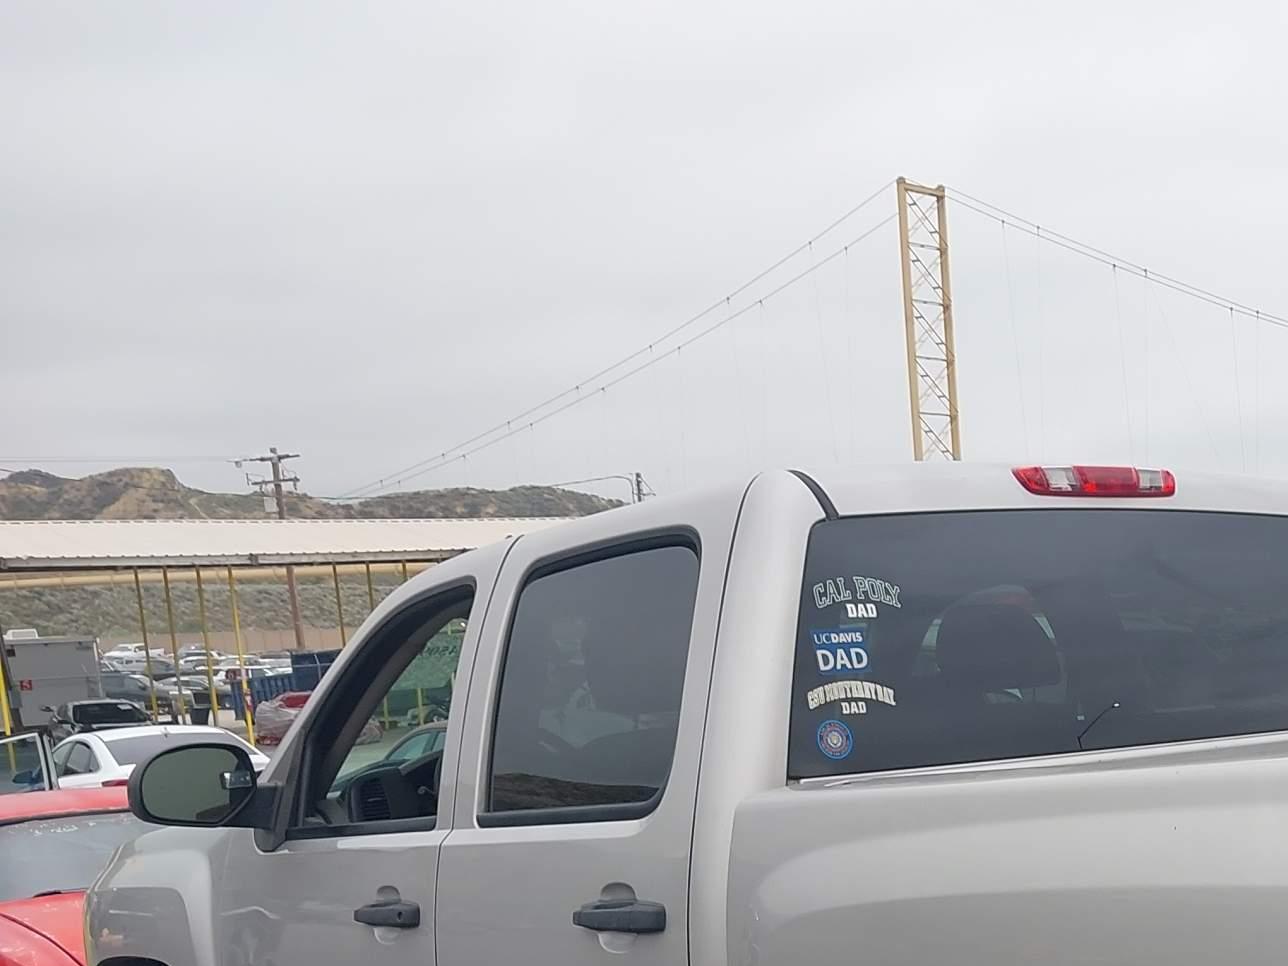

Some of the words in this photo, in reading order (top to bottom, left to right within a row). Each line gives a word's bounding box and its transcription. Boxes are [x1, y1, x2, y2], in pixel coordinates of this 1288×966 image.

[813, 576, 852, 608] CAL
[853, 576, 902, 608] POLY
[846, 603, 878, 618] DAD
[816, 648, 868, 671] DAD
[841, 701, 867, 714] DAD
